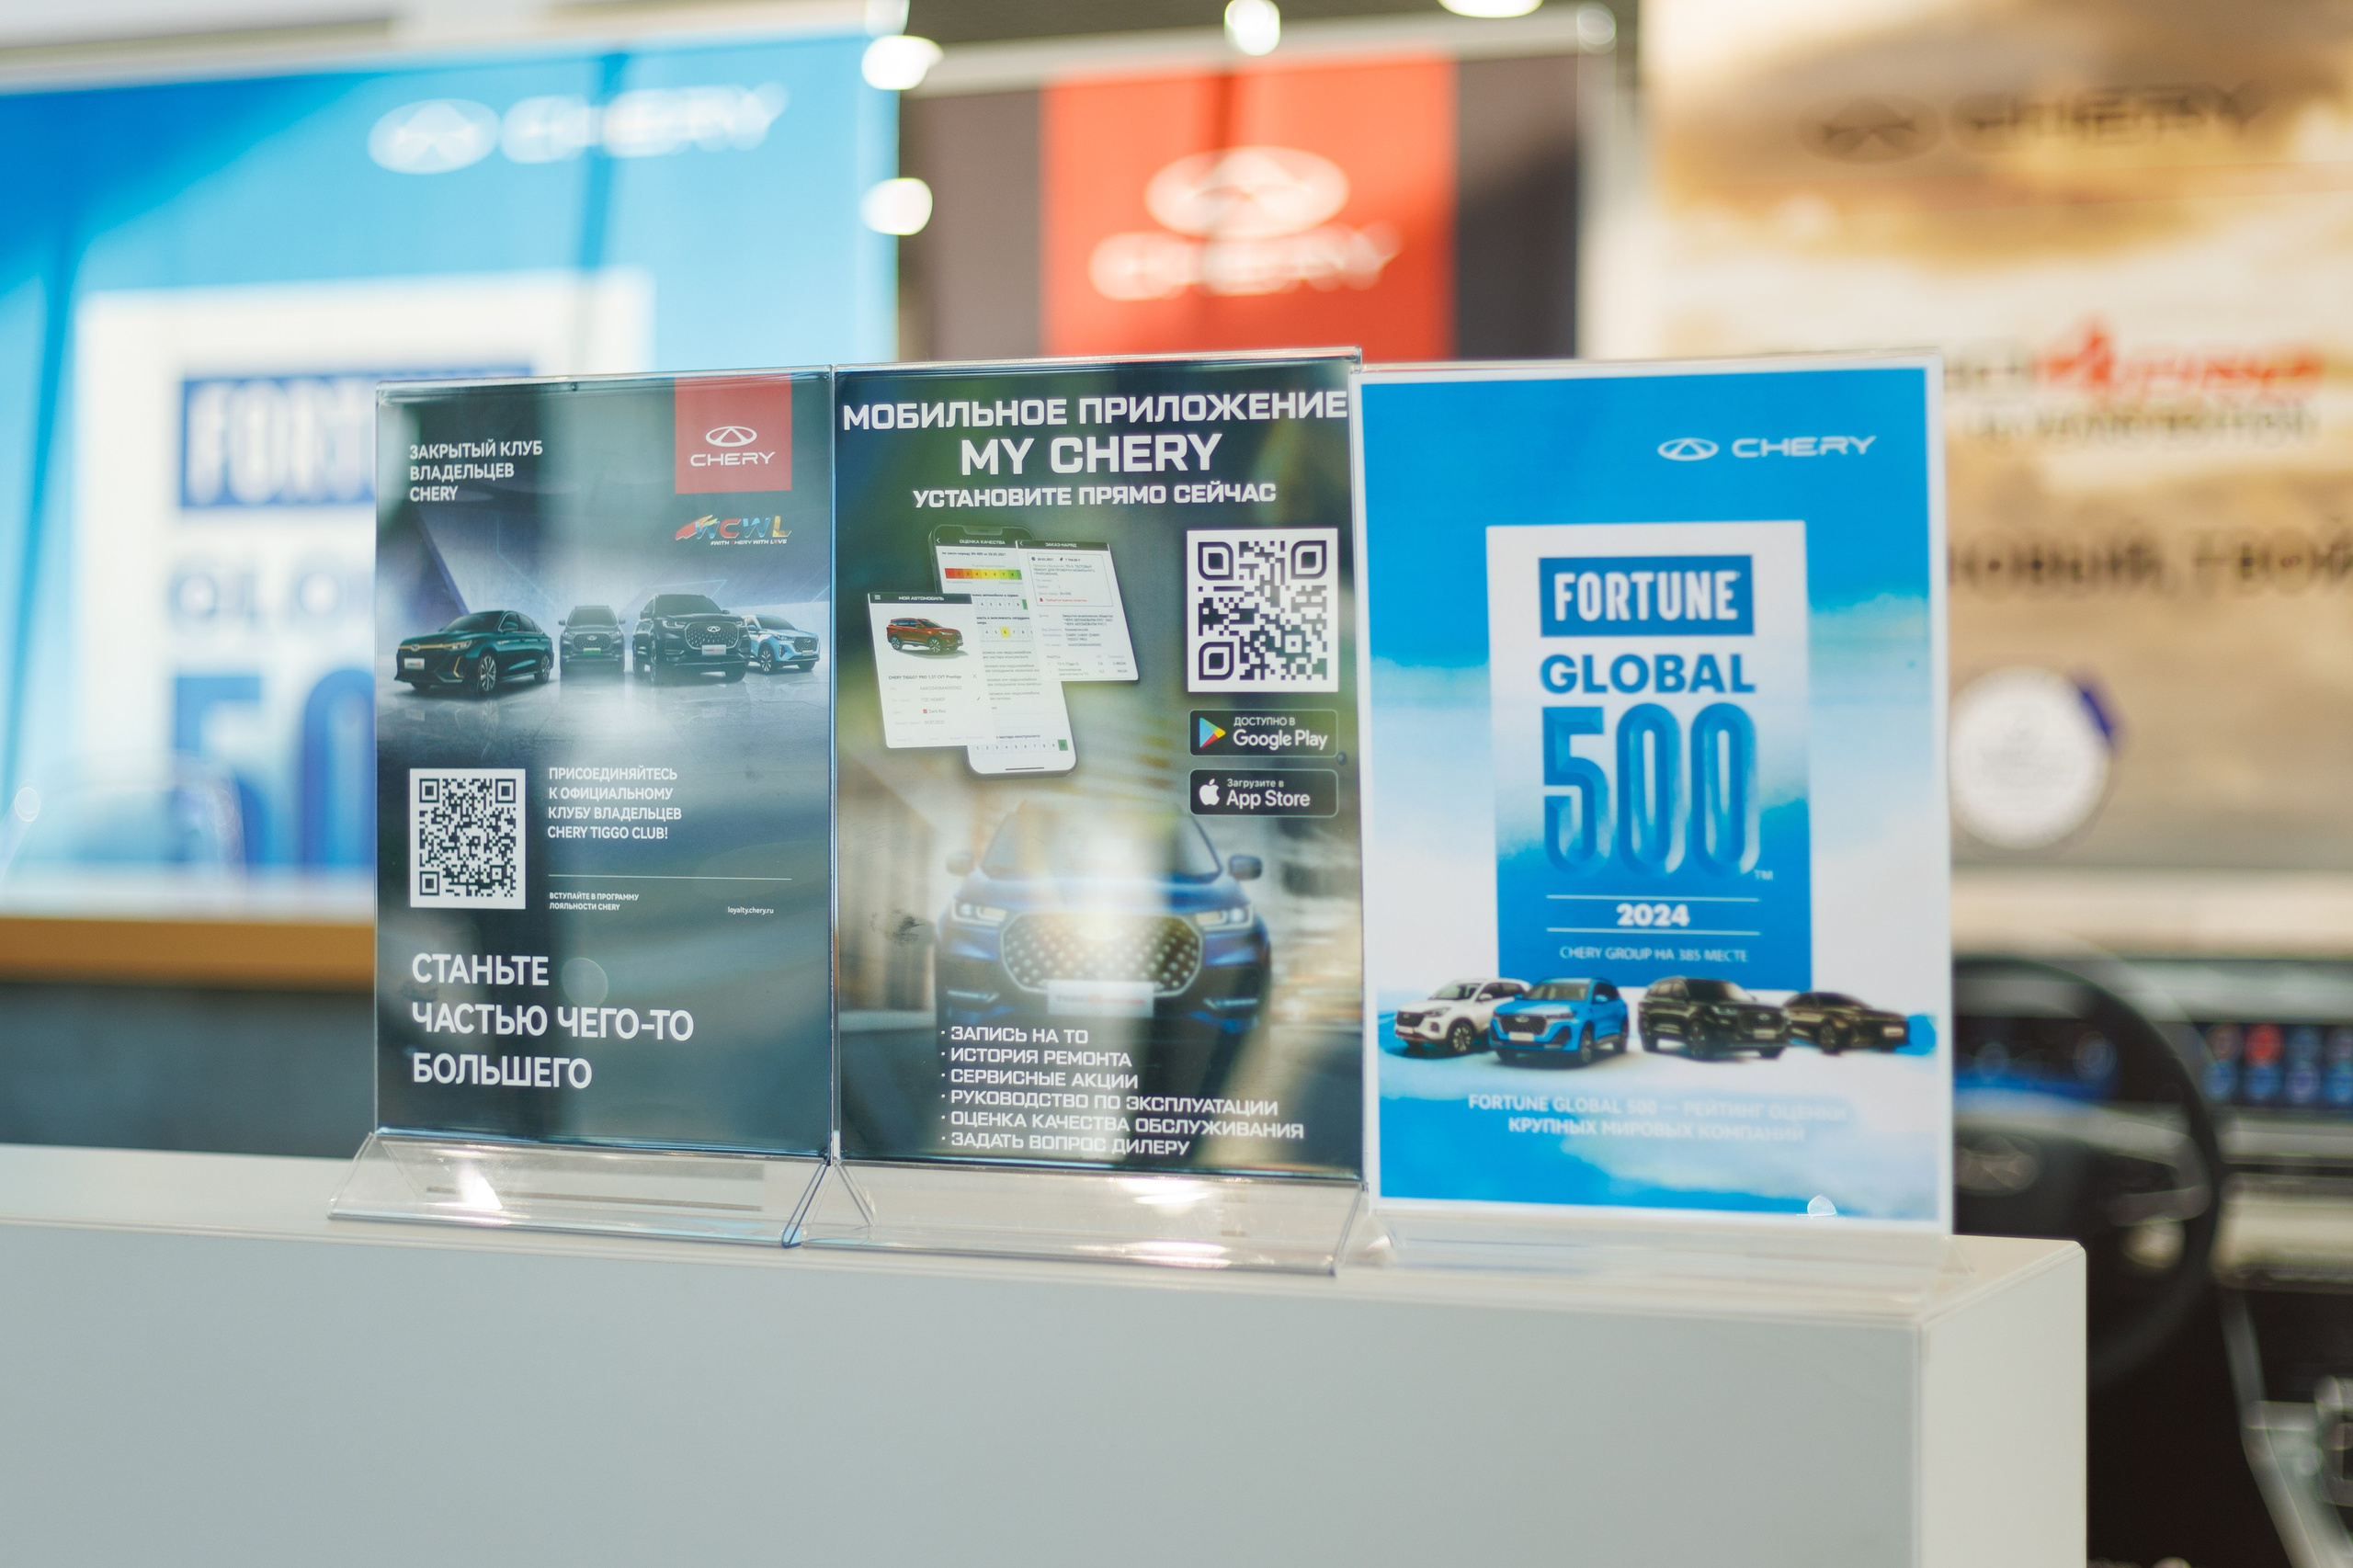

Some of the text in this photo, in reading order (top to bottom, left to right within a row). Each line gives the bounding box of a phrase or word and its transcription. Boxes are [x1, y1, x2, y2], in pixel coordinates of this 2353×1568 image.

[842, 391, 1348, 430] МОБИЛЬНОЕ ПРИЛОЖЕНИЕ
[409, 438, 543, 460] ЗАКРЫТЫЙ КЛУБ
[961, 434, 1223, 476] MY CHERY
[1731, 436, 1878, 458] CHERY
[689, 451, 776, 467] CHERY
[409, 462, 515, 483] ВЛАДЕЛЬЦЕВ
[409, 486, 459, 503] CHERY
[913, 480, 1277, 509] УСТАНОВИТЕ ПРЯМО СЕЙЧАС
[1553, 570, 1742, 622] FORTUNE
[1540, 653, 1756, 695] GLOBAL
[1233, 717, 1295, 727] ДОСТУПНО В
[1233, 729, 1328, 751] Google Play
[549, 765, 677, 781] ПРИСОЕДИНЯЙТЕСЬ
[1227, 778, 1276, 790] Загрузите
[549, 787, 674, 802] К ОФИЦИАЛЬНОМУ
[1226, 790, 1311, 810] App Store
[1541, 702, 1761, 880] 500
[548, 807, 681, 823] КЛУБУ ВЛАДЕЛЬЦЕВ
[548, 825, 668, 840] CHERY TIGGO CLUB!
[549, 892, 590, 901] ВСТУПАЙТЕ
[597, 893, 639, 902] ПРОГРАММУ
[549, 902, 620, 911] ЛОЯЛЬНОСТИ CHERY
[727, 906, 774, 915] loyalty.chery.ru
[1616, 903, 1690, 927] 2024
[1560, 946, 1747, 962] CHERY GROUP НА 385 МЕСТЕ
[412, 952, 550, 987] СТАНЬТЕ
[412, 1002, 694, 1041] ЧАСТЬЮ ЧЕГО-ТО
[950, 1026, 1088, 1044] ЗАПИСЬ НА ТО
[950, 1048, 1132, 1068] ИСТОРИЯ РЕМОНТА
[412, 1051, 593, 1089] БОЛЬШЕГО
[950, 1069, 1139, 1090] СЕРВИСНЫЕ АКЦИИ
[950, 1089, 1279, 1117] РУКОВОДСТВО ПО ЭКСПЛУАТАЦИИ
[1468, 1094, 1549, 1112] FORTUNE
[1552, 1096, 1620, 1114] GLOBAL
[1627, 1099, 1656, 1116] 500
[950, 1111, 1304, 1140] ОЦЕНКА КАЧЕСТВА ОБСЛУЖИВАНИЯ
[1508, 1117, 1597, 1136] КРУПНЫХ
[1602, 1119, 1693, 1139] МИРОВЫХ
[950, 1131, 1190, 1156] ЗАДАТЬ ВОПРОС ДИЛЕРУ
